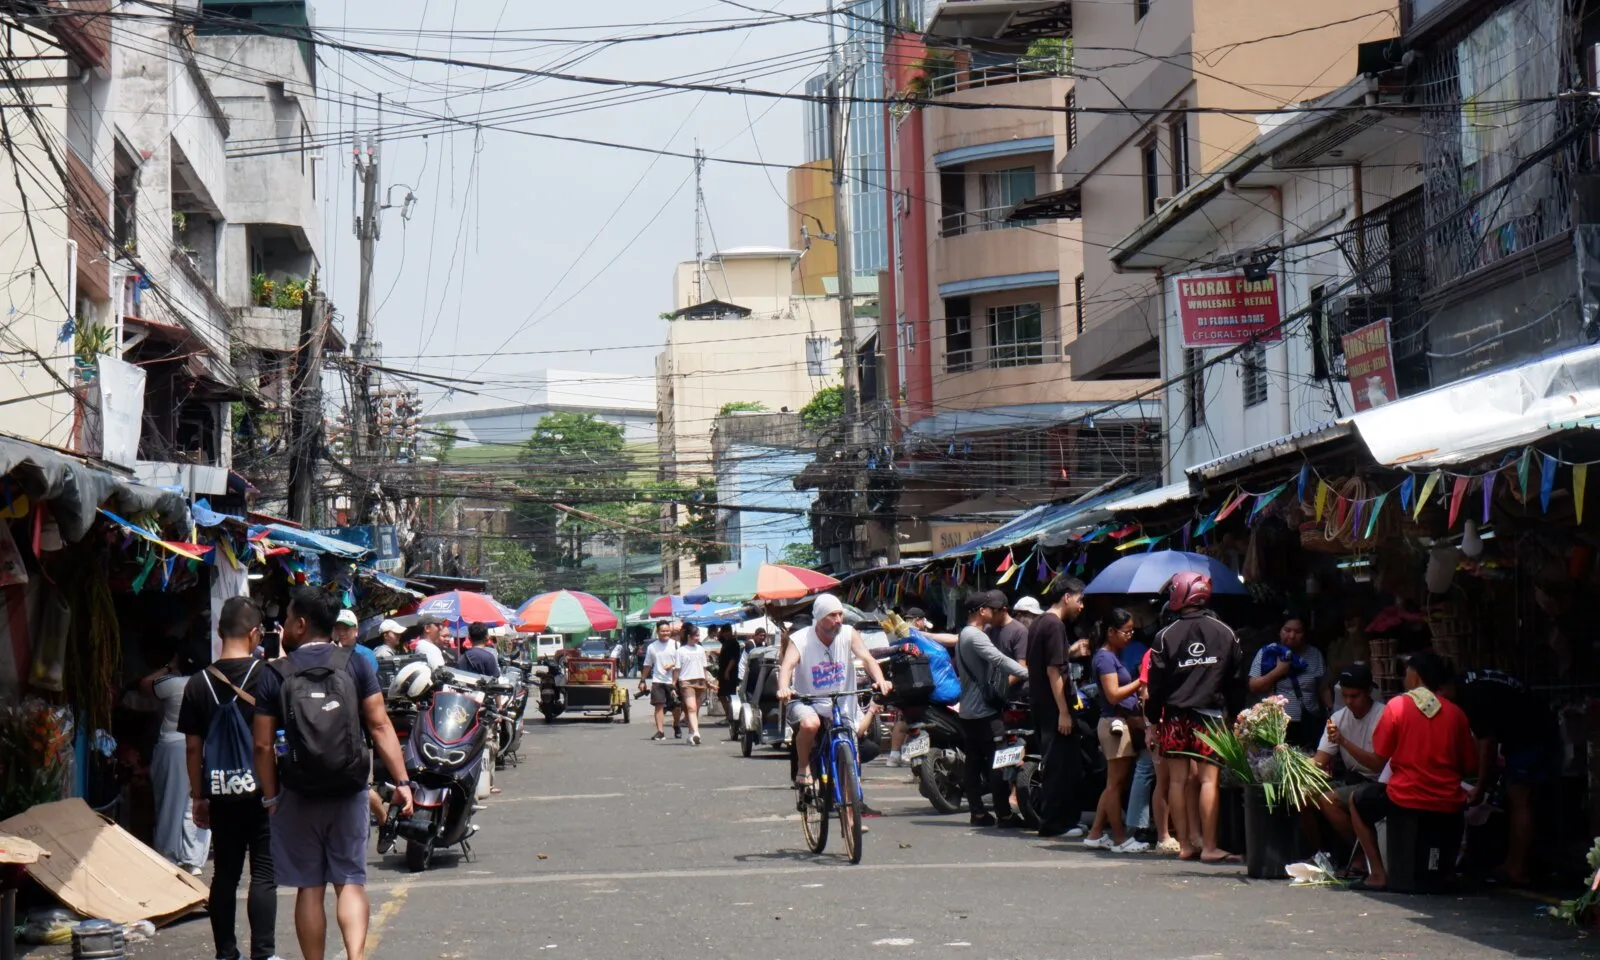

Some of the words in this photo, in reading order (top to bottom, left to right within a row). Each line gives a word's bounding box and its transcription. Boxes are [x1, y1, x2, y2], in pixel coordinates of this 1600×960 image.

[1183, 281, 1232, 296] FLORAL
[1236, 278, 1274, 293] FOAM
[1188, 298, 1236, 309] WHOLESALE
[1244, 296, 1272, 306] RETAIL
[1209, 316, 1238, 326] FLORAL
[1178, 656, 1218, 668] LEXUS
